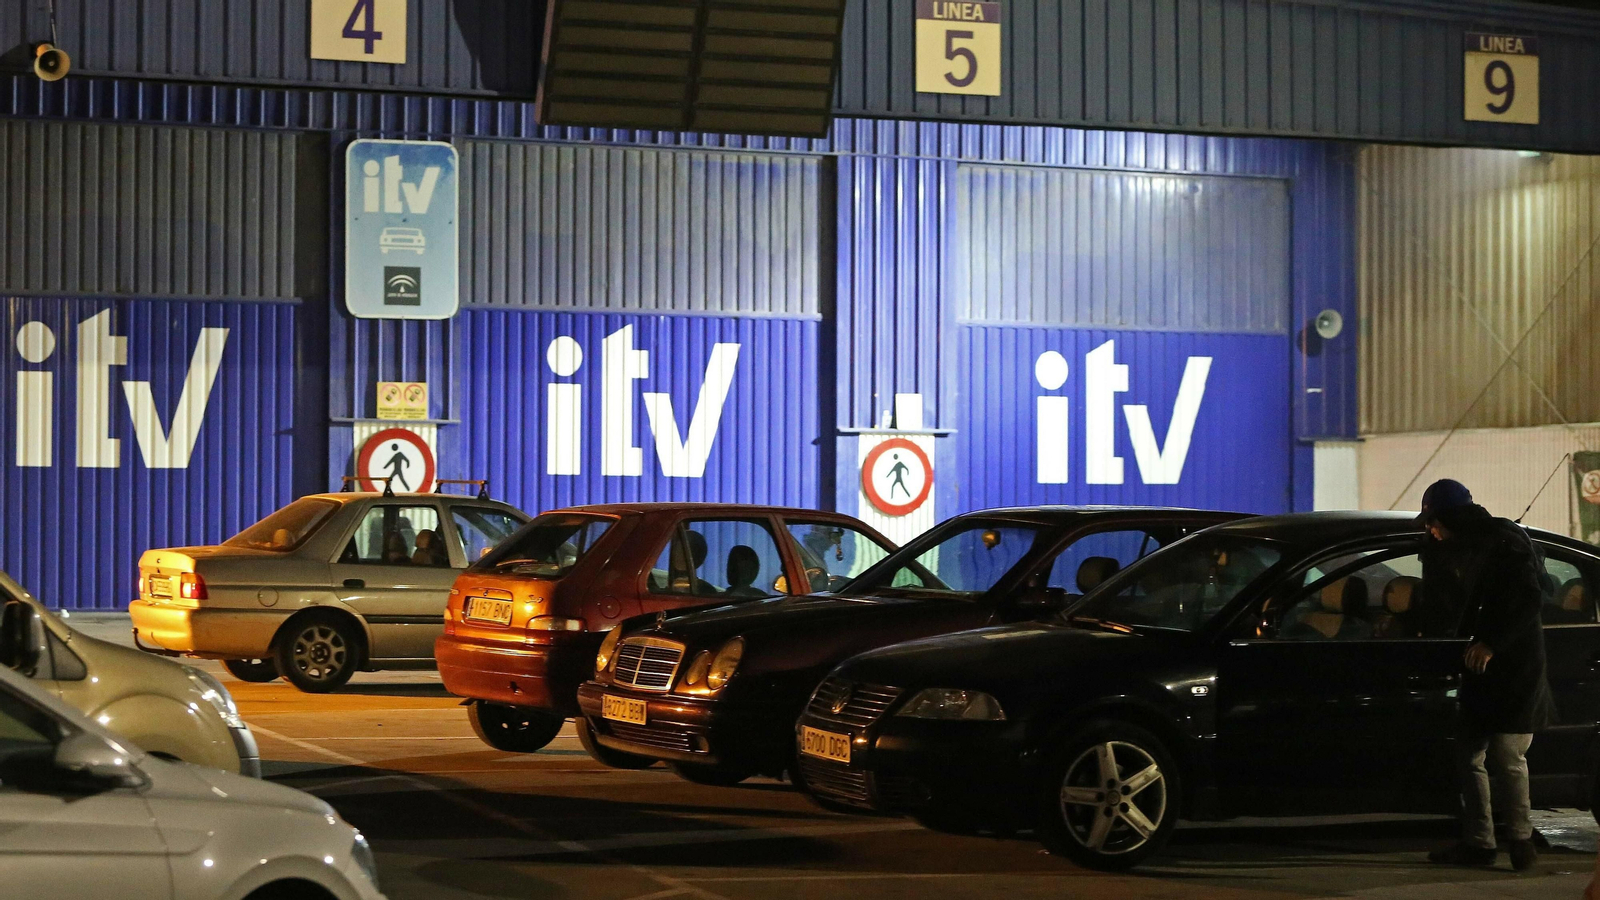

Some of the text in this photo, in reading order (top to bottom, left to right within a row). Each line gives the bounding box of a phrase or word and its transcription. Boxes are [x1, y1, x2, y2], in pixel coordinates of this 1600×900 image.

[342, 0, 382, 54] 4
[933, 1, 984, 20] LINEA
[944, 29, 978, 88] 5
[1480, 35, 1525, 53] LINEA
[1484, 60, 1515, 115] 9
[363, 154, 441, 214] itv
[16, 307, 230, 468] itv
[546, 323, 742, 478] itv
[1035, 339, 1213, 484] itv
[806, 731, 848, 758] 6700 DGC
